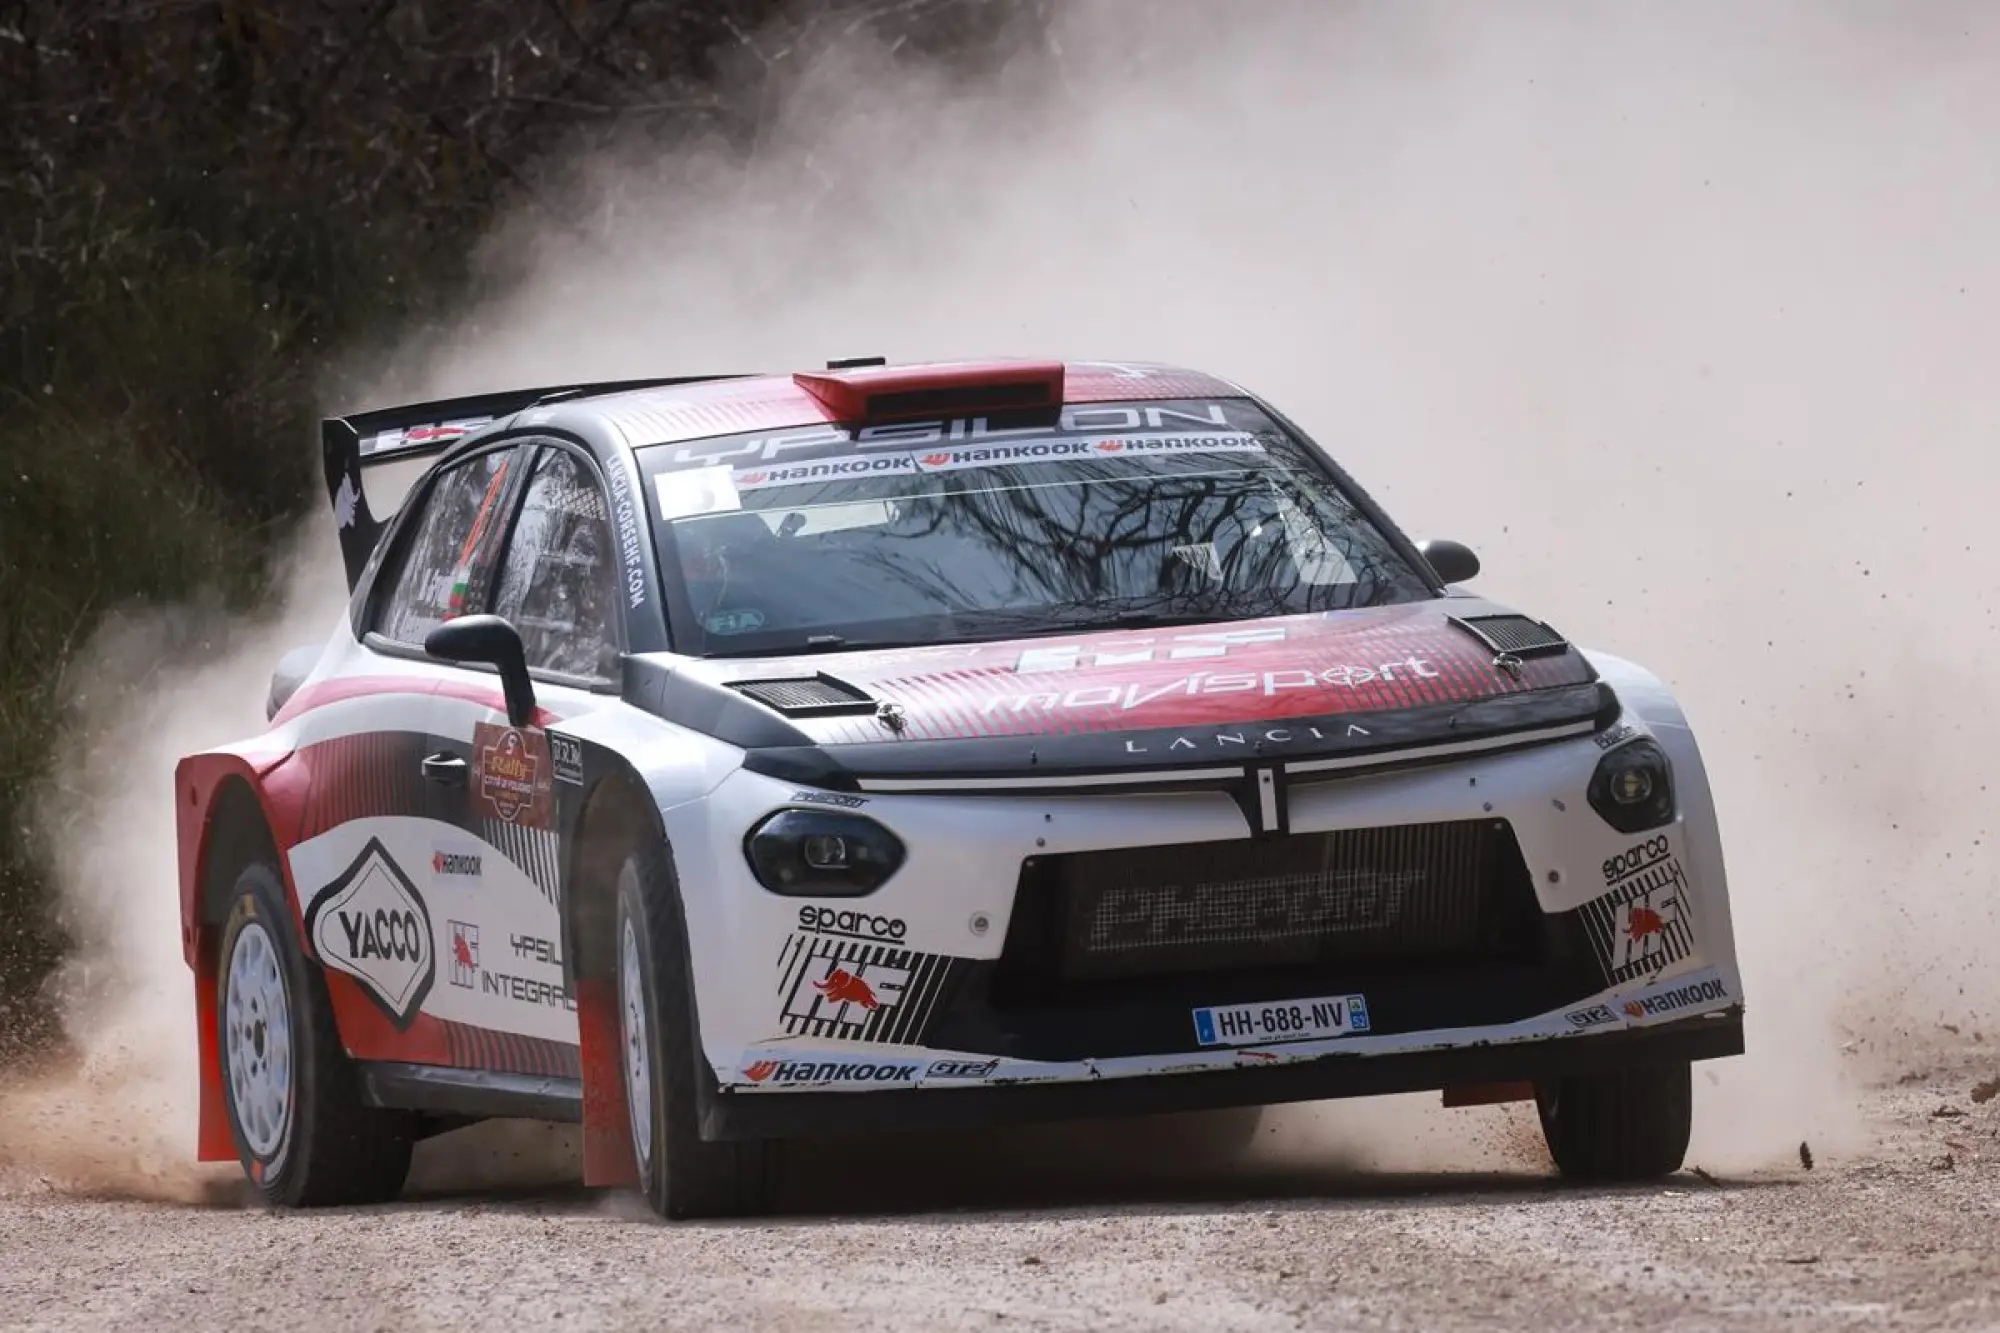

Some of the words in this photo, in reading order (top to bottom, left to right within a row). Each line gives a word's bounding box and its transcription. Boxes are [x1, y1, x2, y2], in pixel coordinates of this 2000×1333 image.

[1125, 724, 1372, 753] LANCIA
[1602, 834, 1670, 882] sparco
[338, 907, 420, 964] YACCO
[798, 904, 908, 938] sparco
[1217, 1002, 1343, 1037] HH-688-NV
